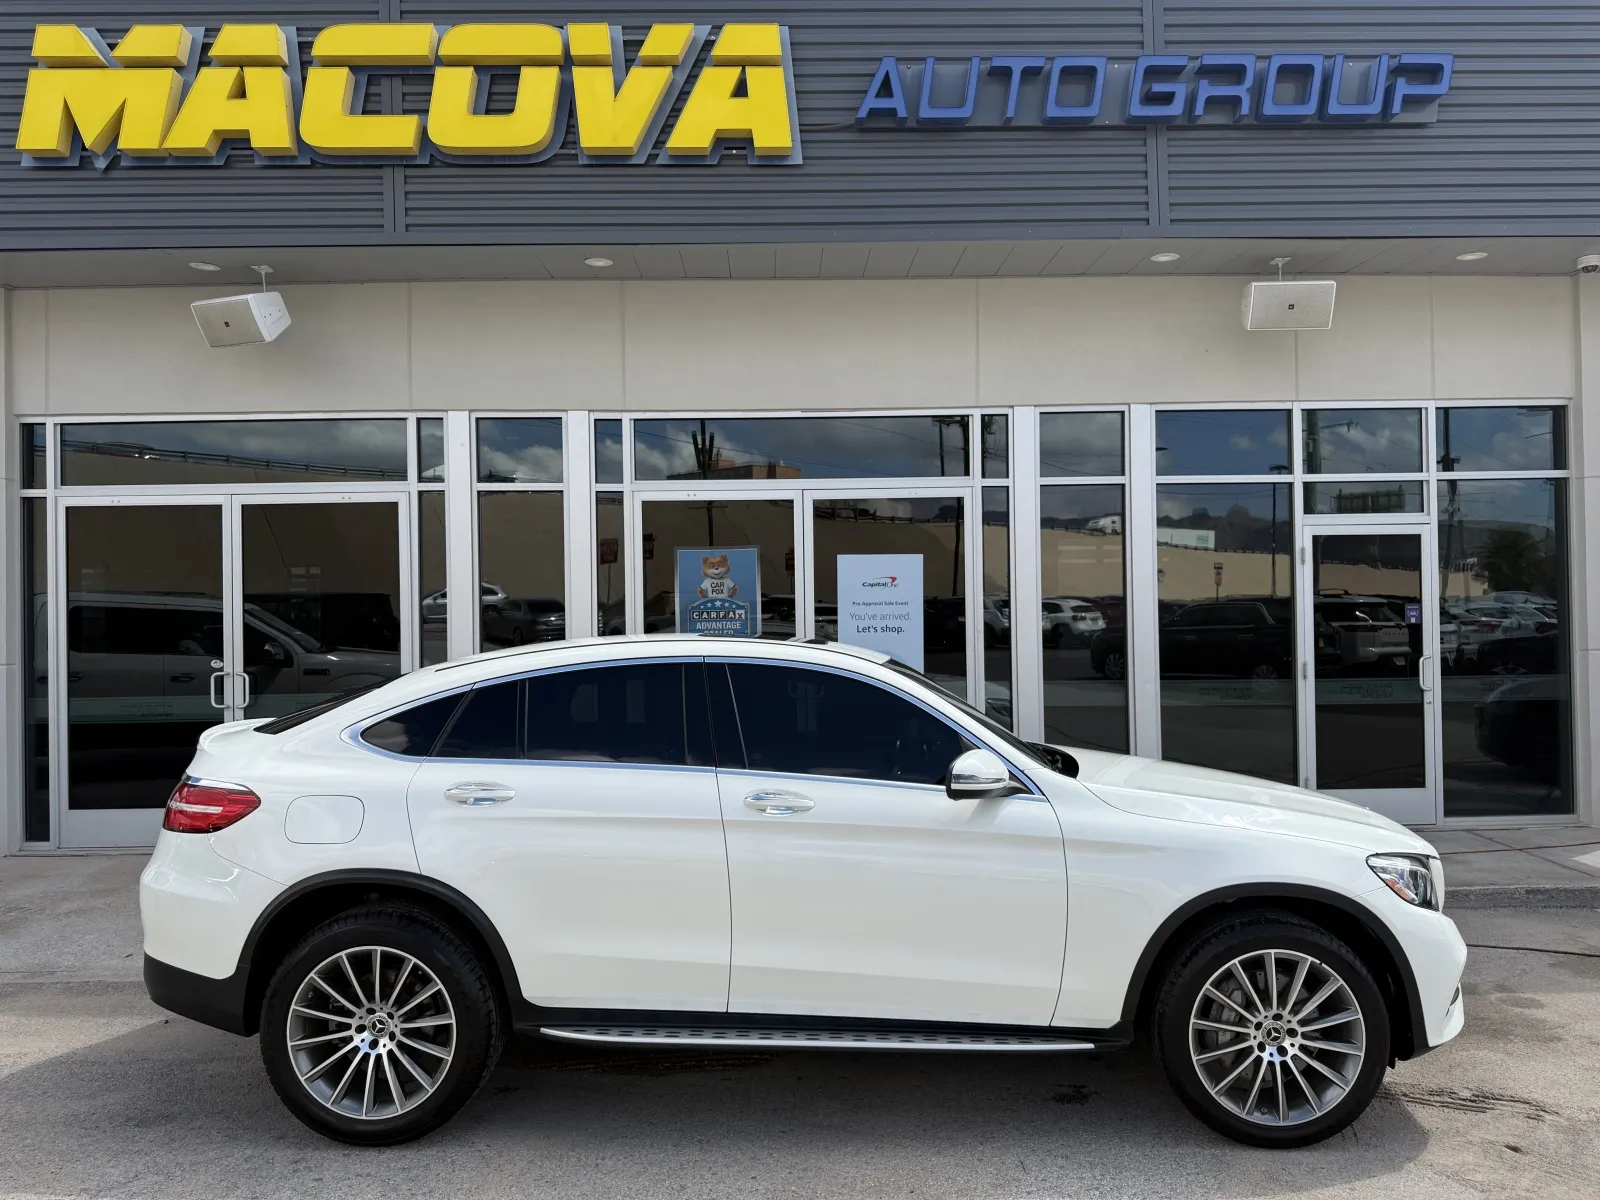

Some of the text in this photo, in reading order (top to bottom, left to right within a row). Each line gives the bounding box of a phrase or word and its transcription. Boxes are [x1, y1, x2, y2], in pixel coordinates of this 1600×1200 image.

[15, 23, 1455, 158] MACOVA AUTO GROUP
[693, 611, 745, 619] CARFAX
[849, 612, 912, 620] You've arrived.
[696, 621, 741, 630] ADVANTAGE
[856, 624, 905, 635] Let's shop.
